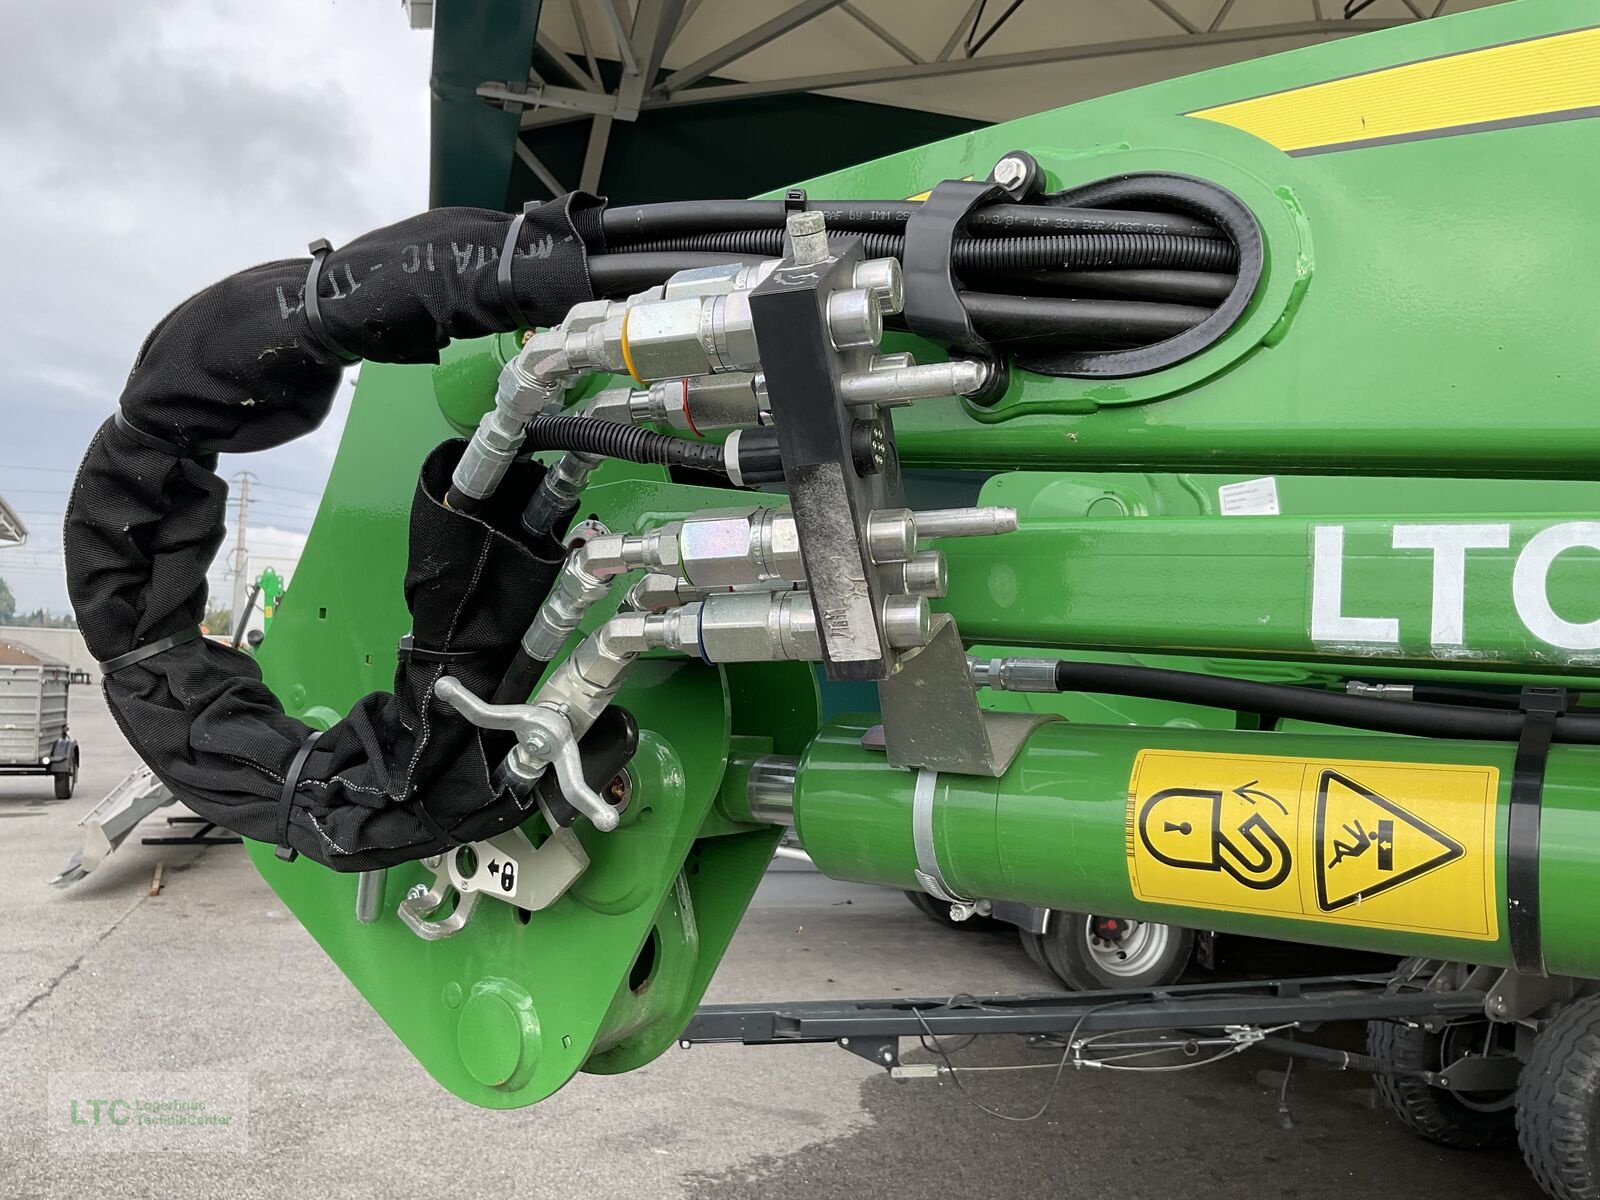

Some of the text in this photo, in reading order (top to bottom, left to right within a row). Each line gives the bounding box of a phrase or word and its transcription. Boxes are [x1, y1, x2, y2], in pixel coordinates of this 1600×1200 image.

[849, 210, 863, 221] by
[870, 210, 892, 221] IMM
[1054, 218, 1077, 229] 330
[1146, 223, 1168, 234] PSI
[1311, 521, 1600, 651] LTC
